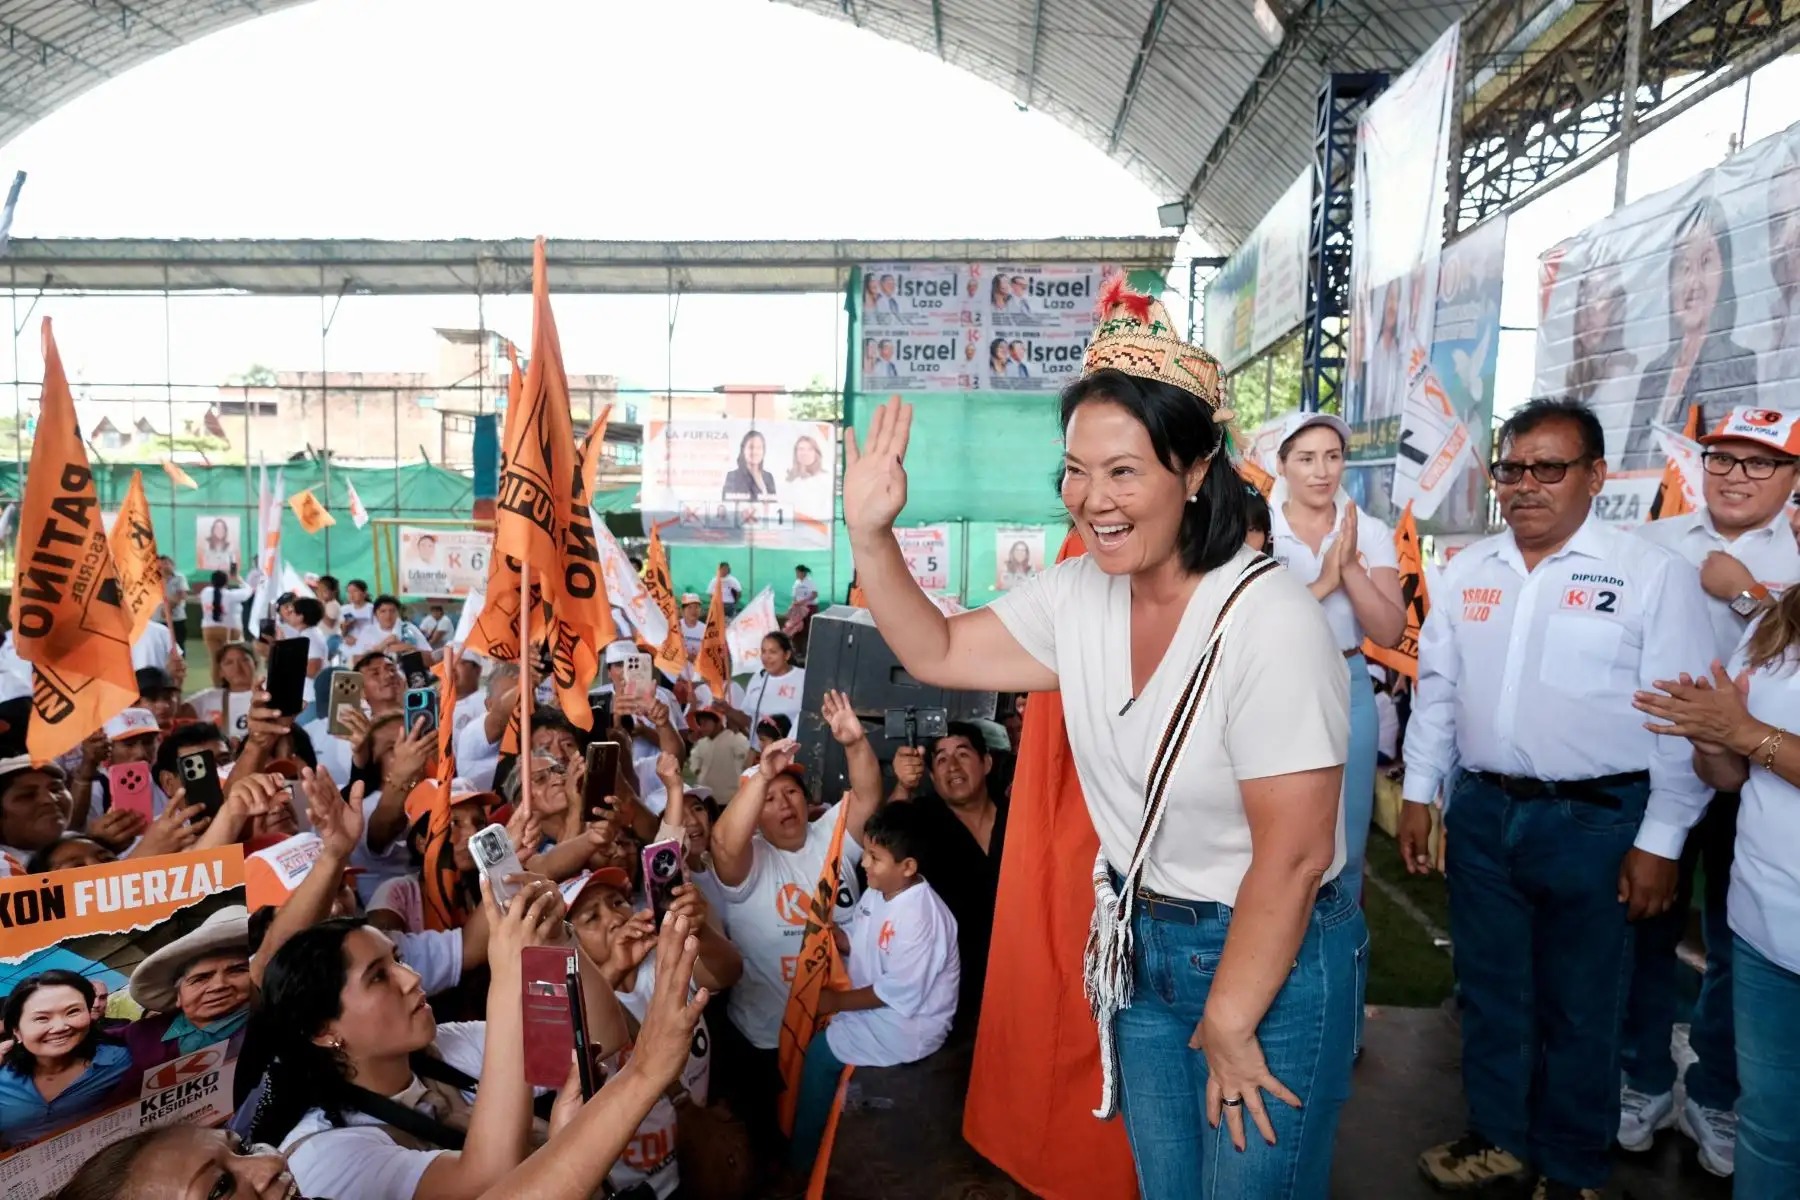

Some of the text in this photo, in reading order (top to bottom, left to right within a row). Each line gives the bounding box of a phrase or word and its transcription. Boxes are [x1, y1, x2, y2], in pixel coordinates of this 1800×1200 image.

[897, 273, 958, 296] Israel
[1028, 275, 1090, 297] Israel
[912, 297, 943, 308] Lazo
[1043, 298, 1075, 309] Lazo
[896, 338, 955, 360] Israel
[910, 361, 940, 372] Lazo
[1042, 363, 1073, 373] Lazo
[683, 431, 729, 440] FUERZA
[471, 552, 484, 570] 6
[928, 556, 938, 572] 5
[1571, 573, 1624, 587] DIPUTADO
[1462, 587, 1503, 605] ISRAEL
[1567, 590, 1617, 613] K 2
[73, 860, 224, 917] FUERZA!
[140, 1071, 219, 1116] KEIKO
[140, 1084, 218, 1127] PRESIDENTA
